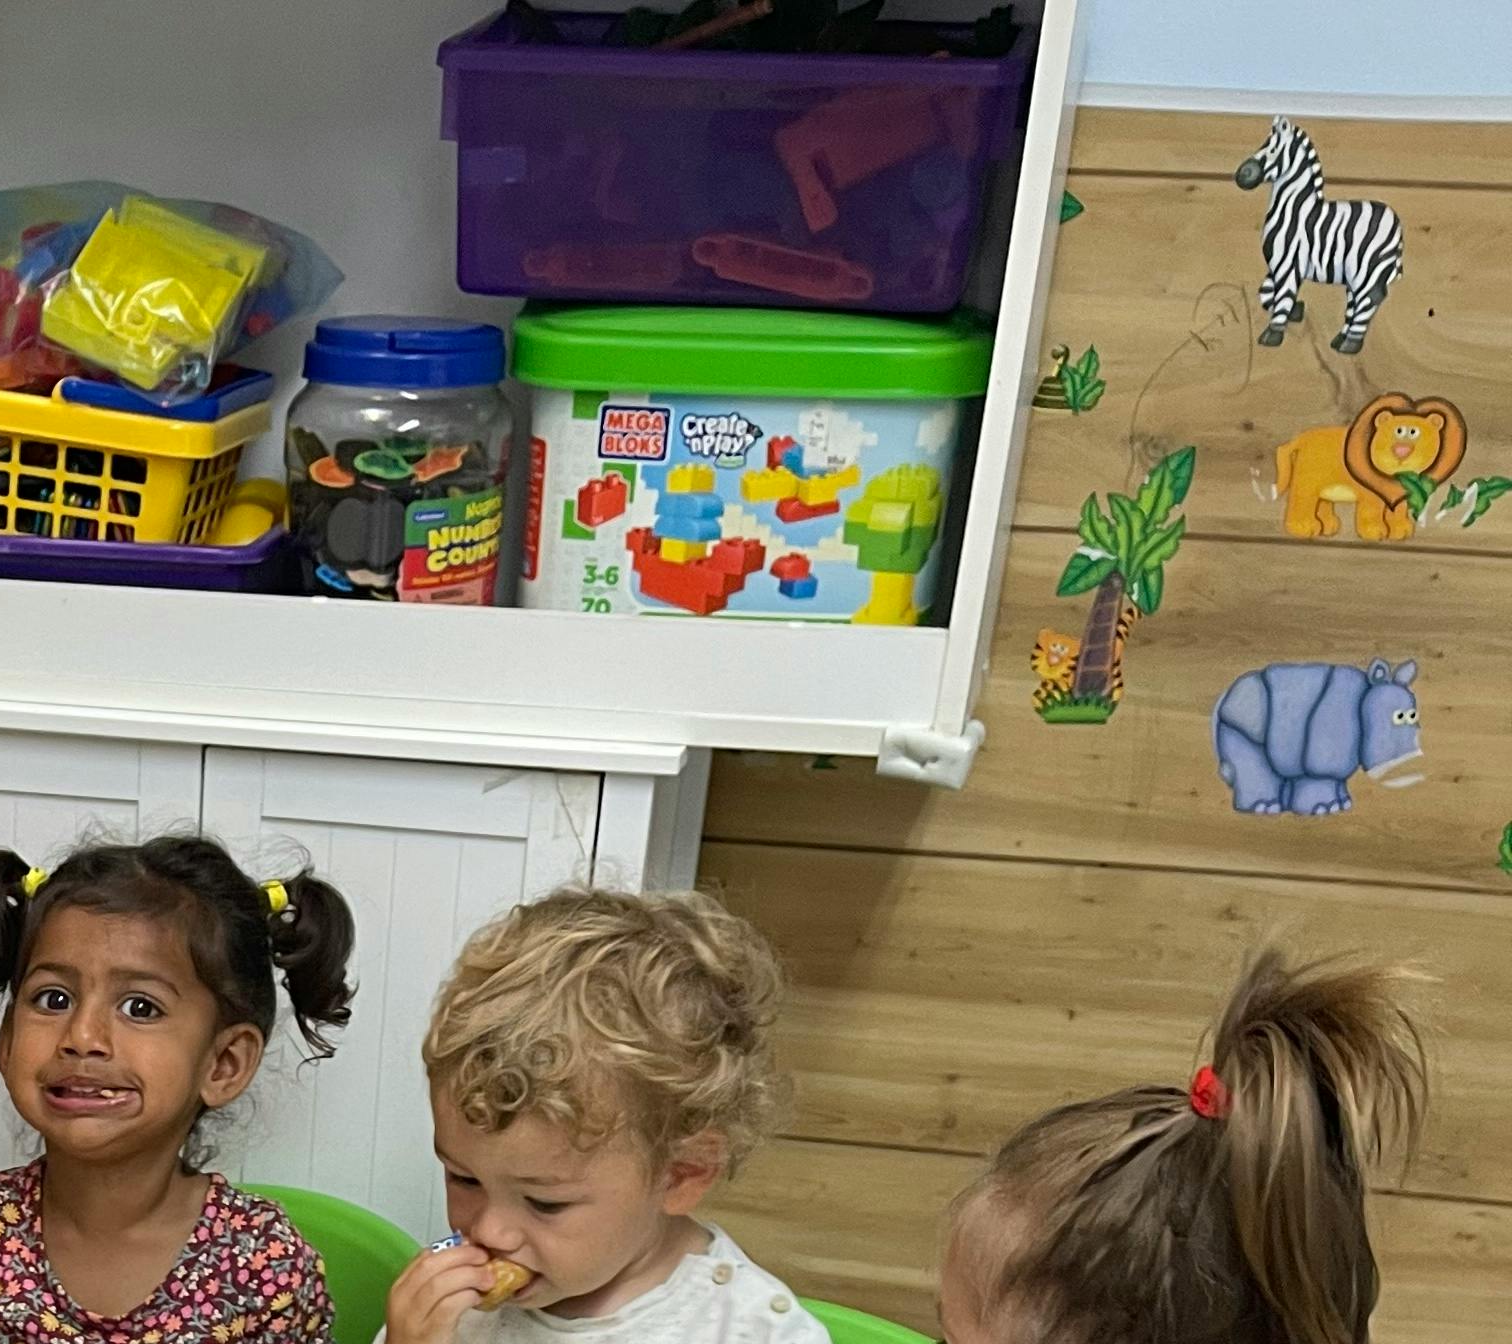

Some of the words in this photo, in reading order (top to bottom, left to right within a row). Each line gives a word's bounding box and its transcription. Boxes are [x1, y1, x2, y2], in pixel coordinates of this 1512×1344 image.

[605, 409, 666, 432] MEGA
[682, 412, 748, 437] Create
[602, 433, 662, 457] BLOKS
[583, 564, 619, 585] 3-6
[581, 598, 612, 613] 70
